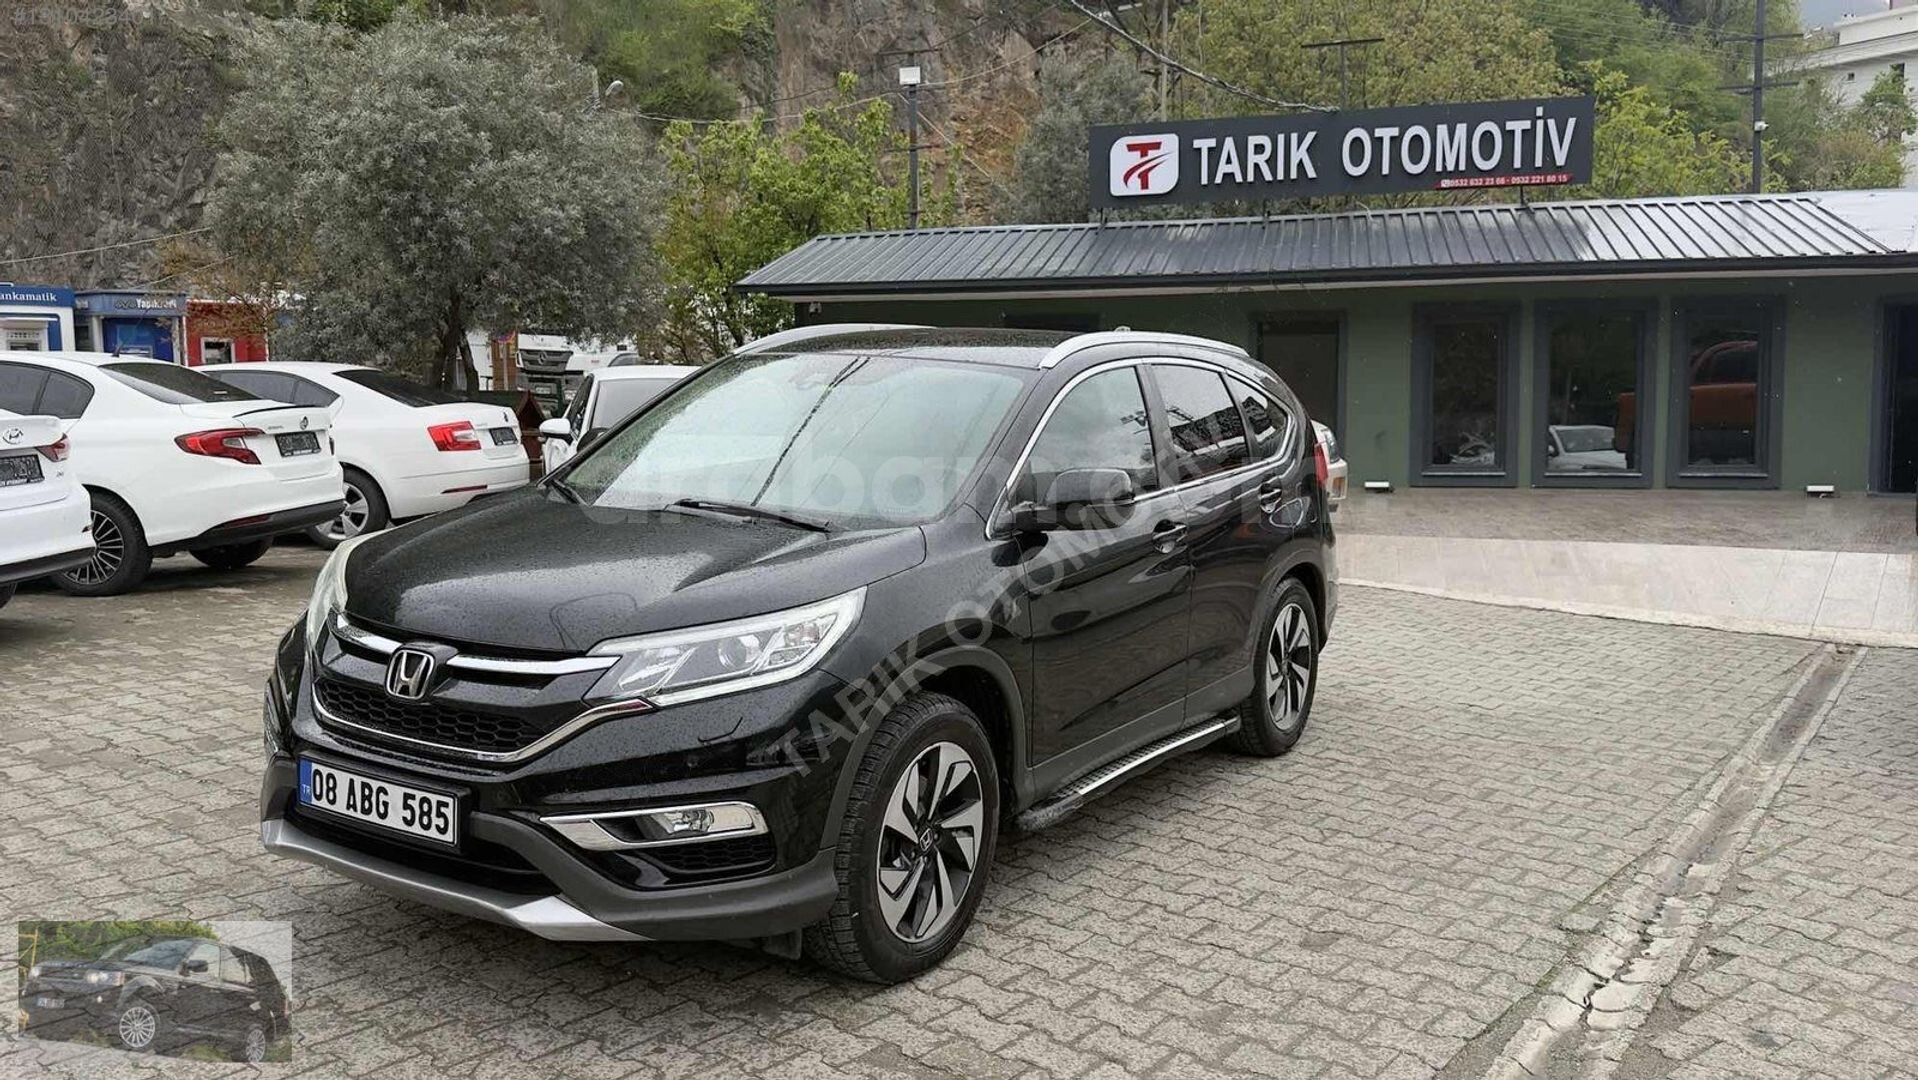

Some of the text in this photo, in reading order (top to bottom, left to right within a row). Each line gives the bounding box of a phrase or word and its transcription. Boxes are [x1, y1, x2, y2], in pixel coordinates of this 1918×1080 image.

[1192, 106, 1577, 186] TARIK OTOMOTİV
[302, 768, 450, 836] TR 08 ABG 585
